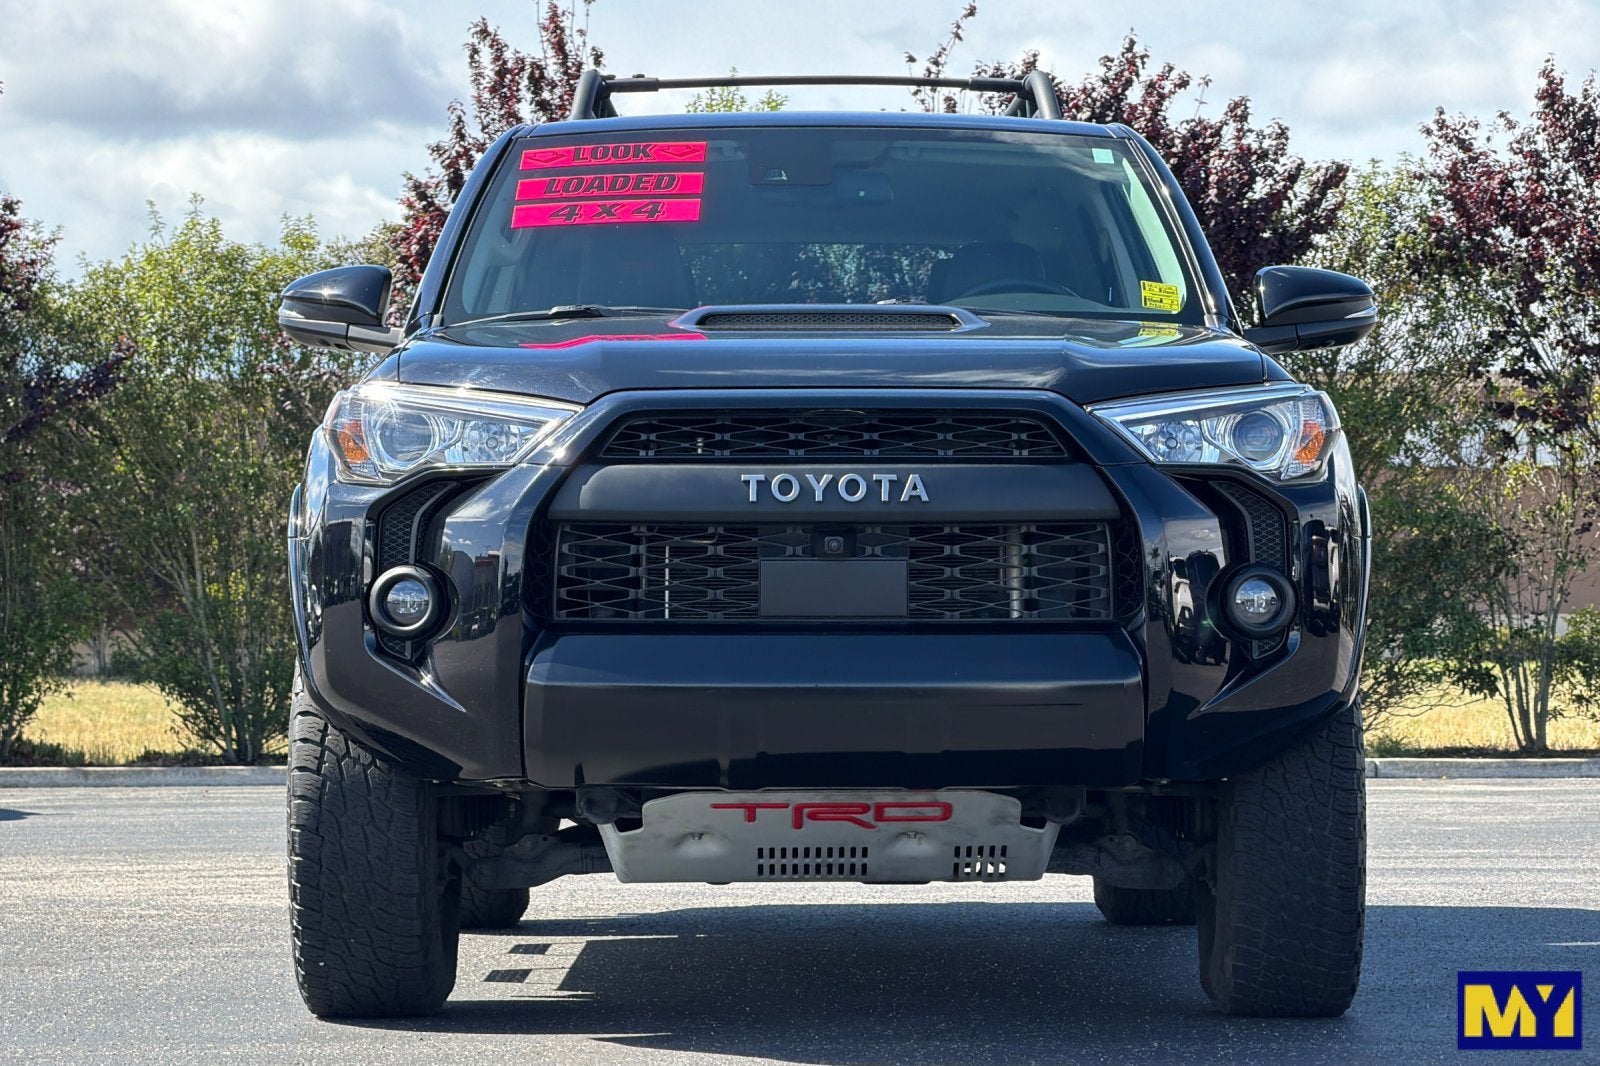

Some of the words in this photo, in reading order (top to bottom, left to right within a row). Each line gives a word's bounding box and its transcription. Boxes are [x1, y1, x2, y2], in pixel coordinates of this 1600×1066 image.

[572, 144, 656, 162] LOOK
[544, 174, 680, 195] LOADED
[741, 473, 930, 502] TOYOTA
[710, 801, 953, 829] TRD
